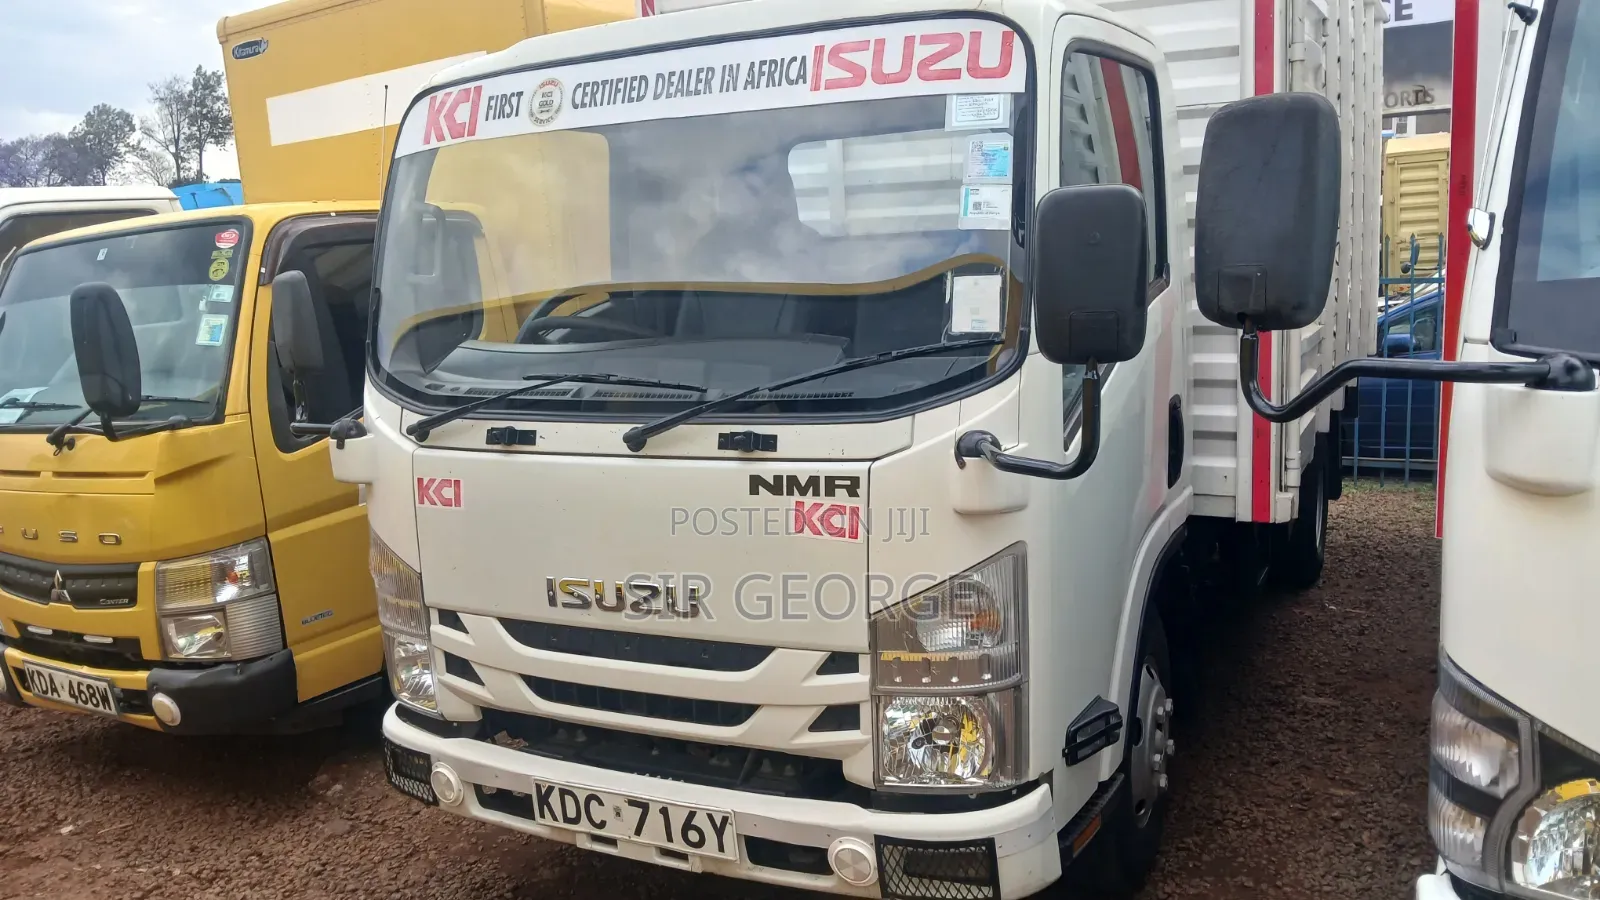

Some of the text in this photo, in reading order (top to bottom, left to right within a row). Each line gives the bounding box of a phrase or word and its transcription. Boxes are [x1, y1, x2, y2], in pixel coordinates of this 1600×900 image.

[810, 31, 1015, 91] ISUZU
[539, 80, 559, 89] ISUZU
[539, 99, 554, 107] GOLD
[571, 75, 649, 110] CERTIFIED
[652, 66, 715, 100] DEALER
[719, 63, 741, 93] IN
[743, 55, 807, 90] AFRICA
[423, 85, 483, 145] KCI
[485, 91, 524, 121] FIRST
[417, 477, 462, 508] KCI
[749, 474, 860, 497] NMR
[0, 525, 122, 545] USO
[794, 500, 860, 540] KCI
[546, 575, 700, 618] ISUZU
[27, 667, 112, 711] KDA 468W
[535, 783, 730, 853] KDC 716Y
